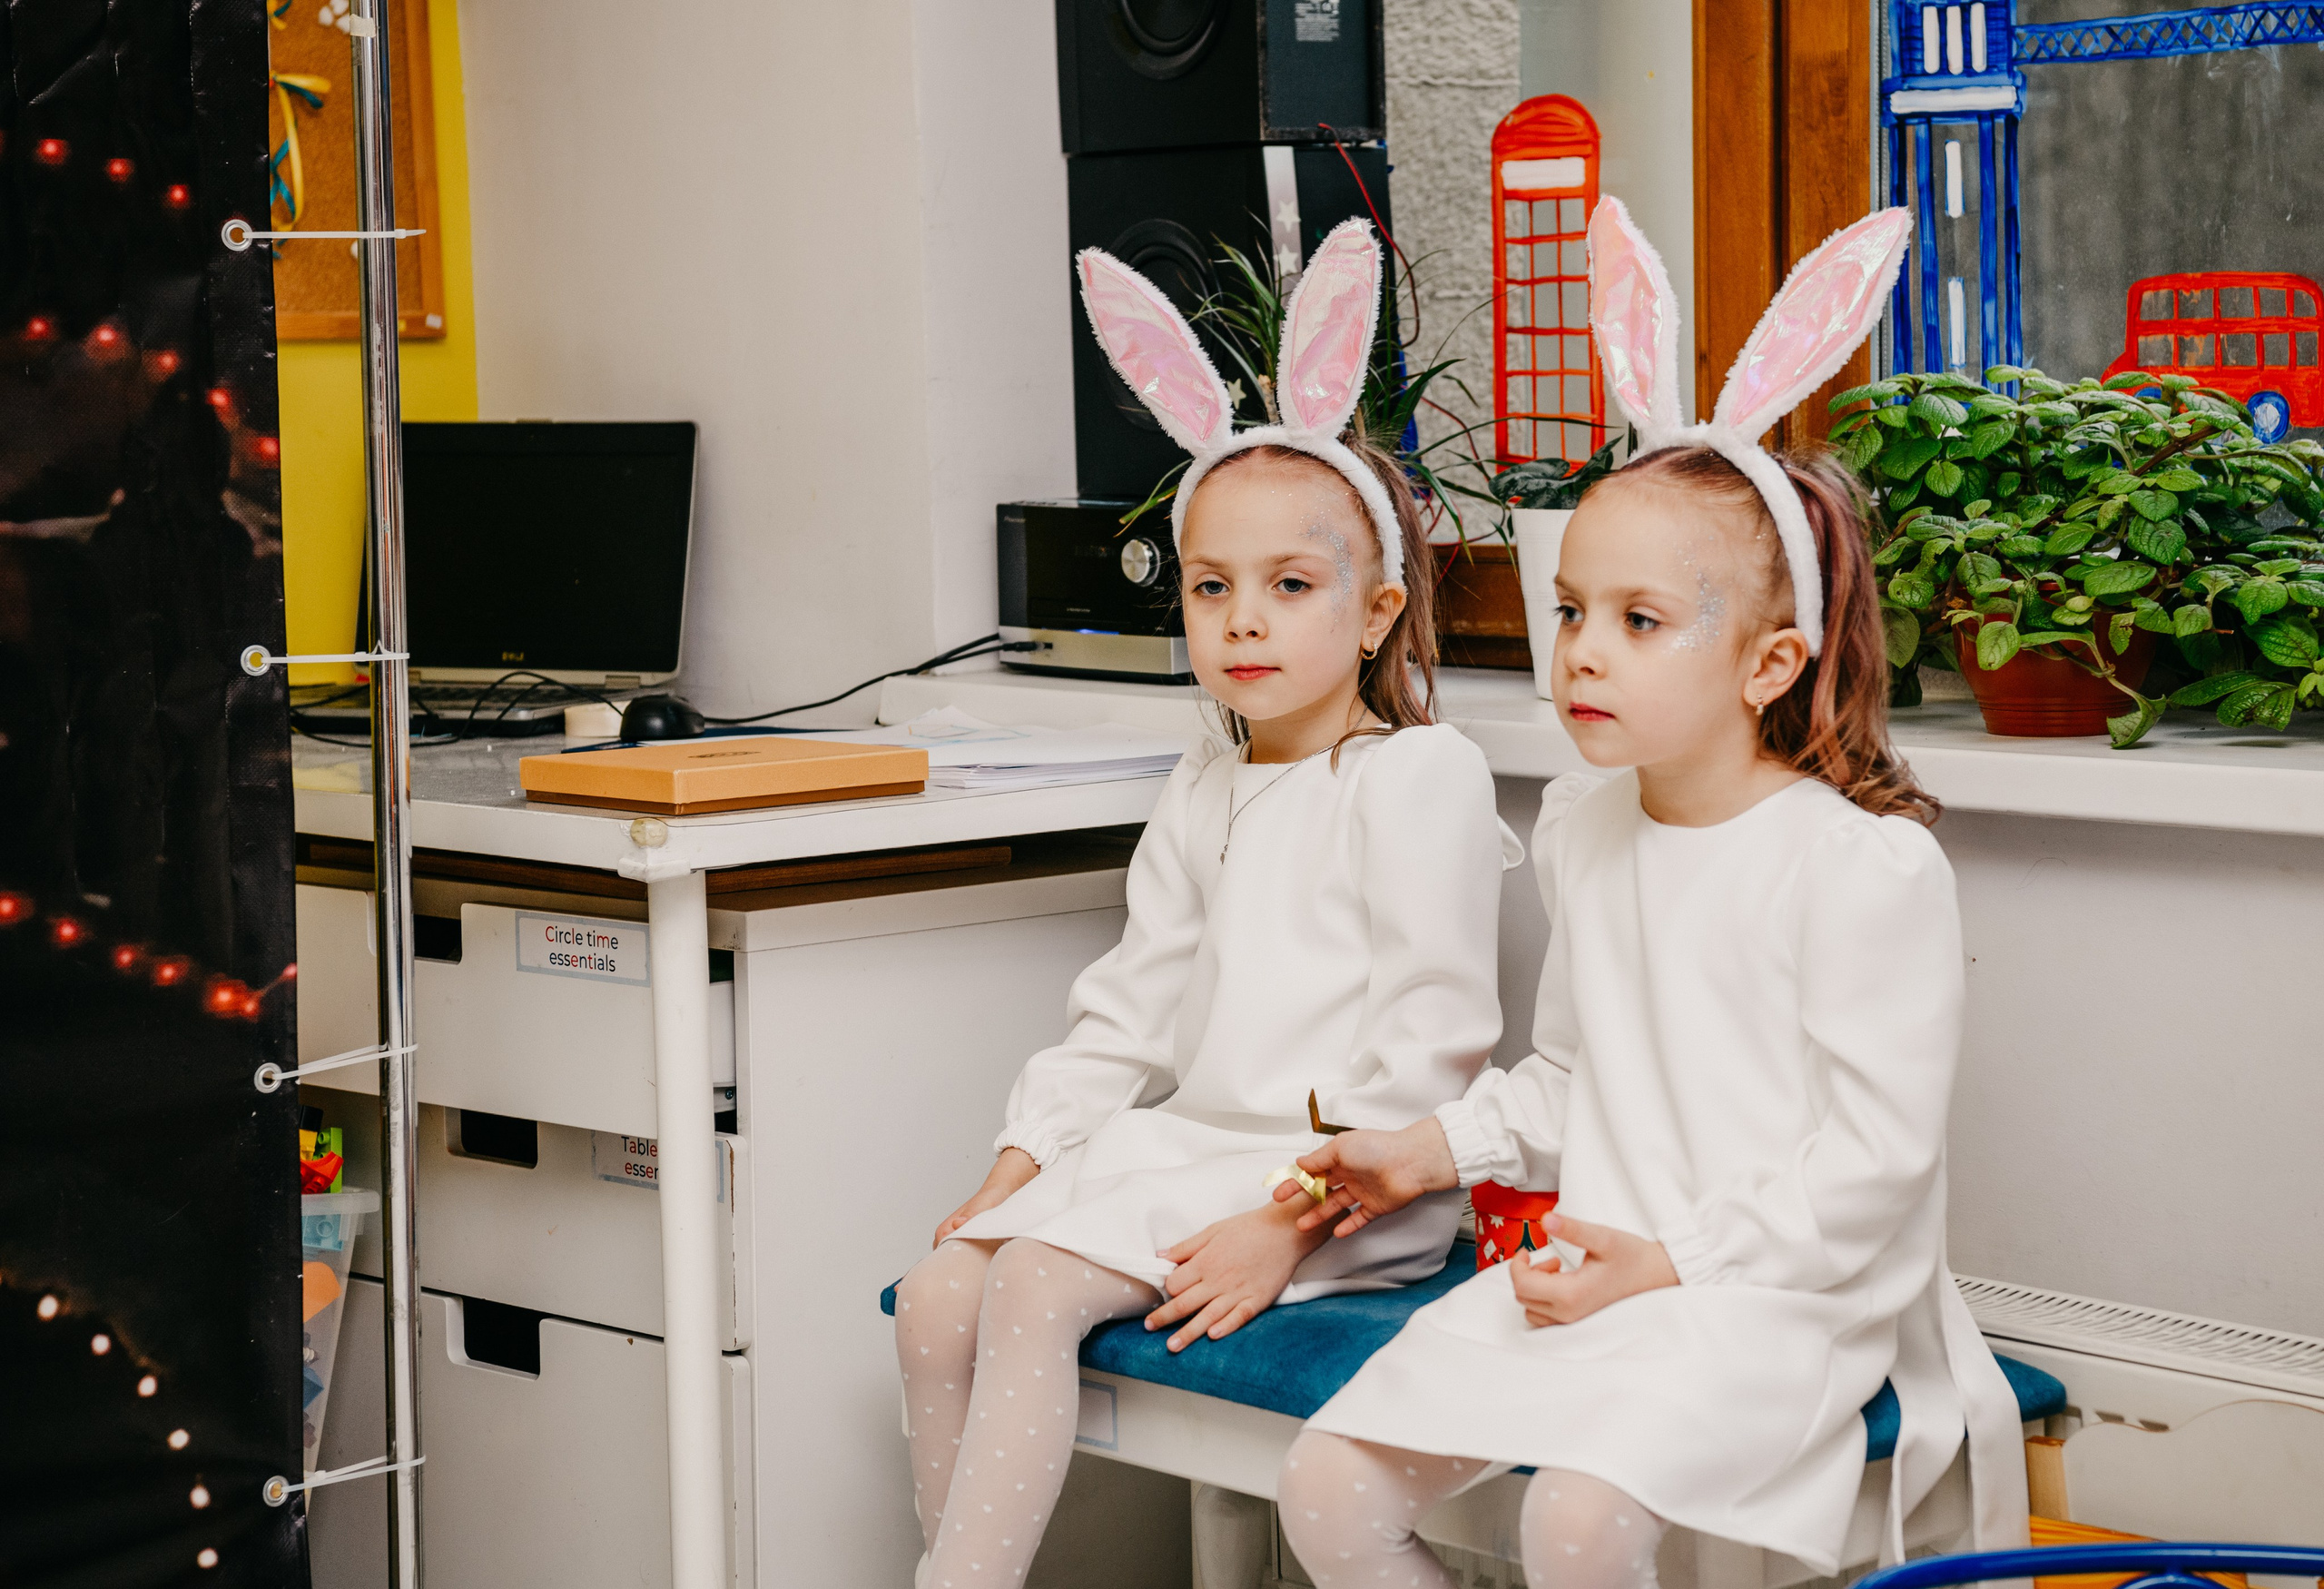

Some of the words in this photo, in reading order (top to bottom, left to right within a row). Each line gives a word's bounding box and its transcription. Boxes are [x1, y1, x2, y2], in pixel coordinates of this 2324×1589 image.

[545, 925, 584, 945] Circle
[586, 930, 619, 950] time
[549, 952, 616, 972] essentials
[621, 1136, 658, 1158] Table
